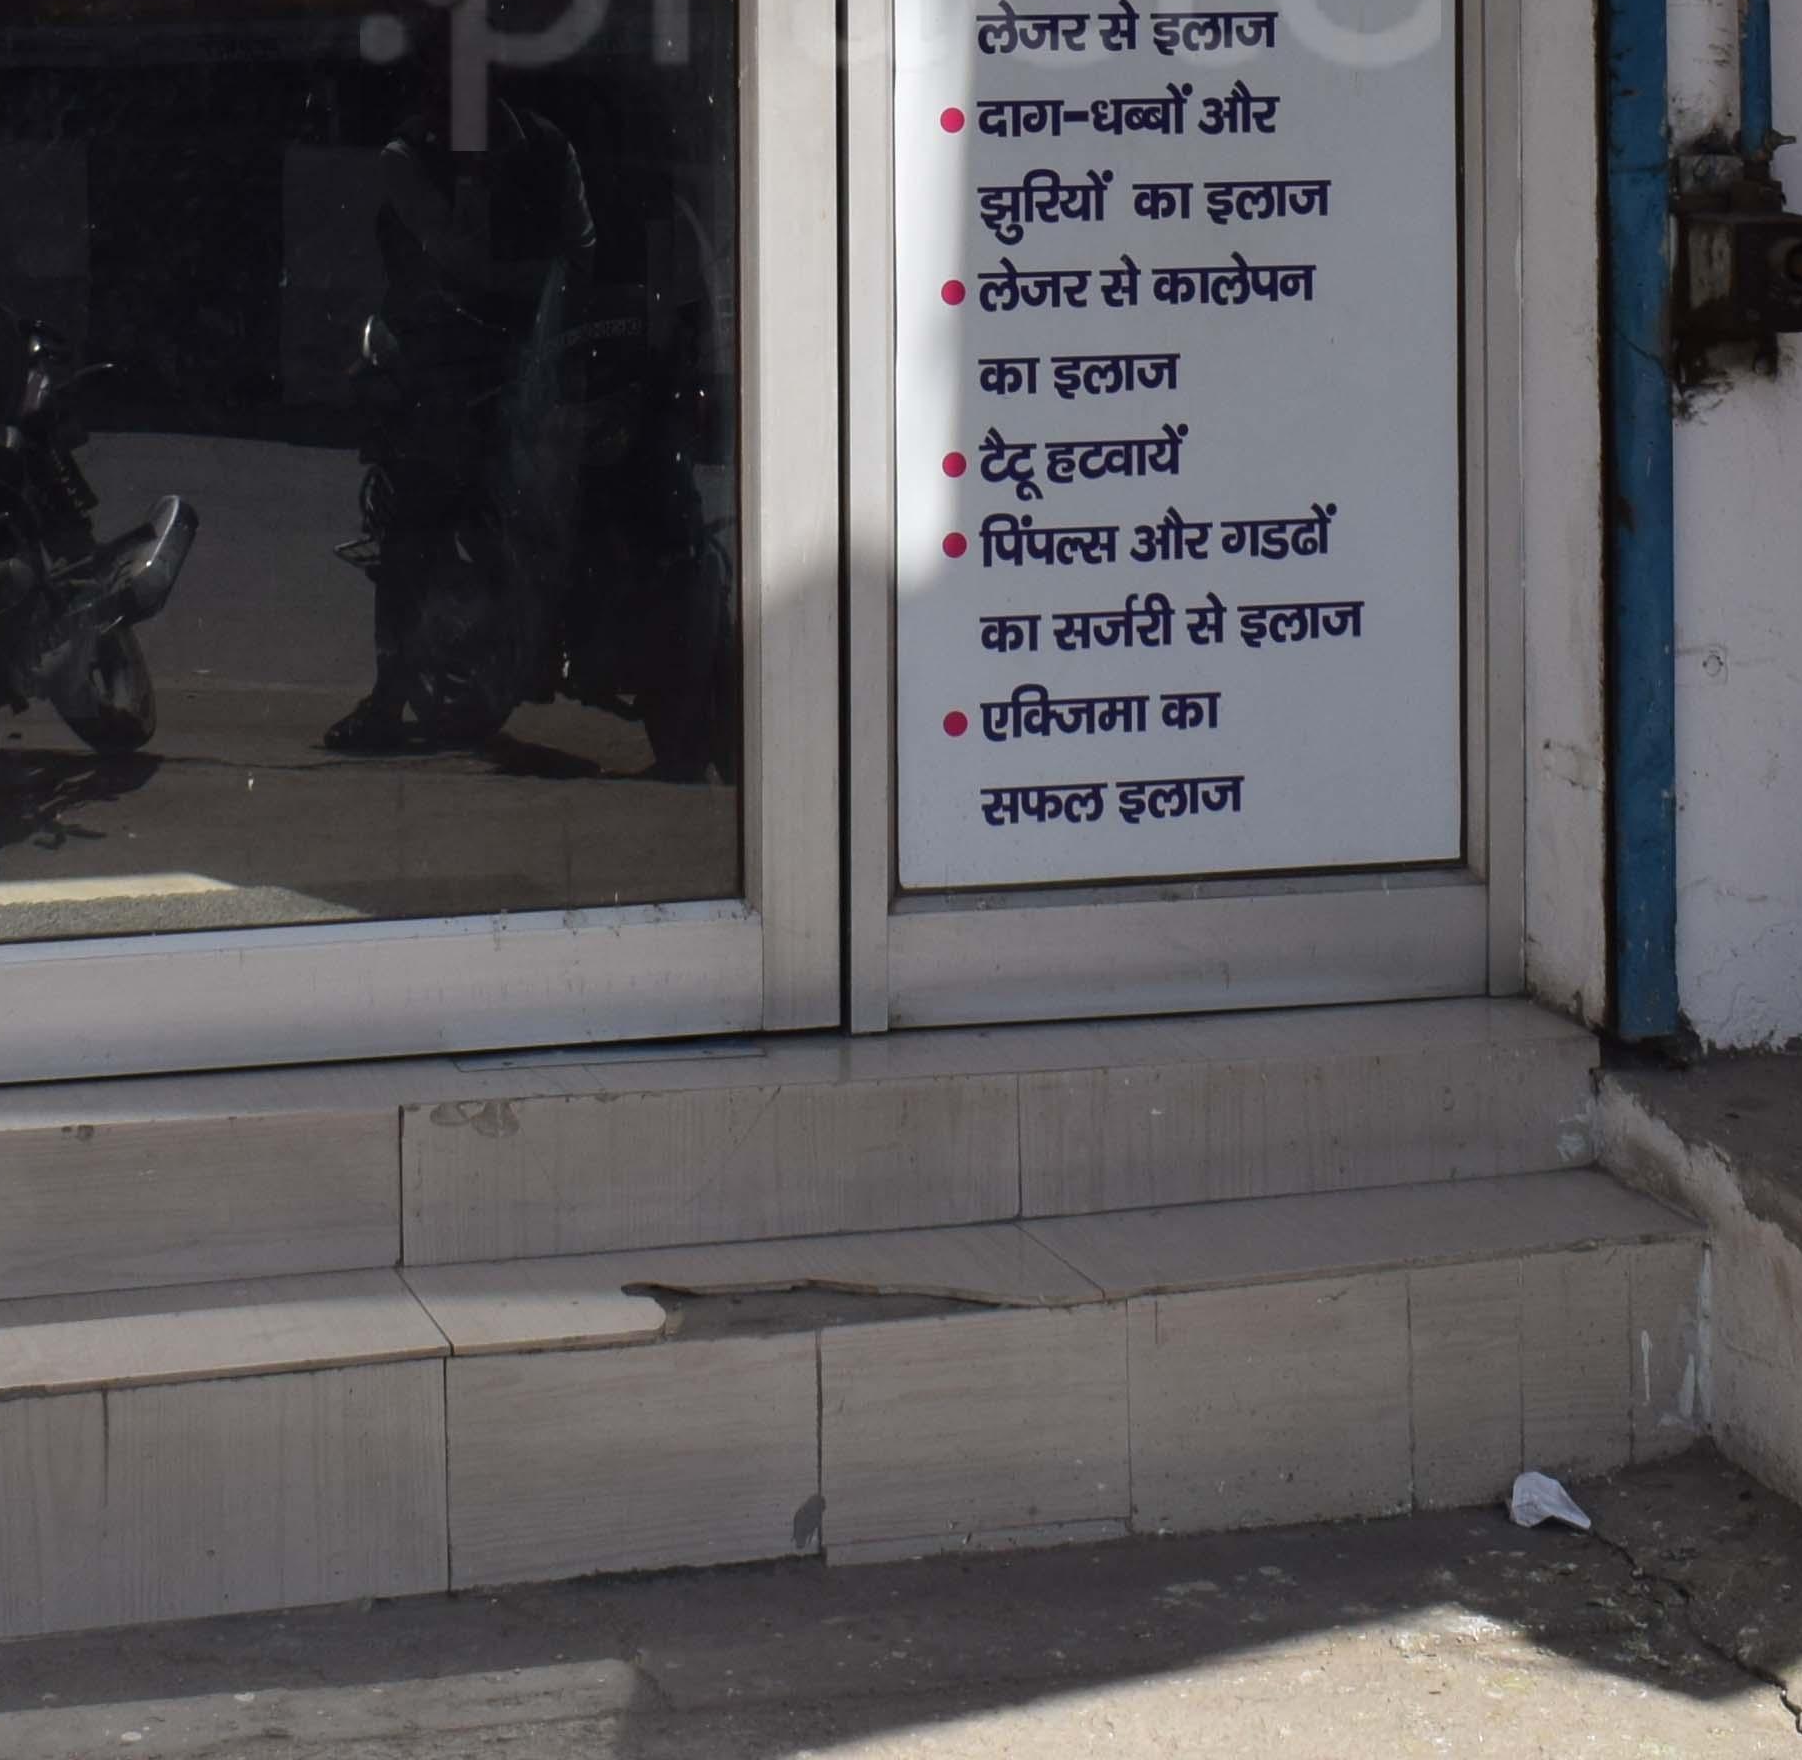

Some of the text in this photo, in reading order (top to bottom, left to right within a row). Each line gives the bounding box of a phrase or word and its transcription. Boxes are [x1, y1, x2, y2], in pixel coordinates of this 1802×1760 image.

[977, 0, 1091, 54] लेजर
[1150, 12, 1278, 56] इलाज
[1198, 80, 1280, 134] और
[1133, 183, 1193, 219] का
[1204, 180, 1331, 225] इलाज
[978, 252, 1316, 312] लेजर से कालेपन
[978, 353, 1180, 399] का इलाज
[979, 424, 1188, 501] टैटू हटवायें
[979, 513, 1119, 567] पिंपल्स
[1130, 507, 1213, 562] और
[980, 592, 1364, 652] का सर्जरी से इलाज
[1160, 692, 1221, 730] का
[981, 776, 1245, 826] सफल इलाज
